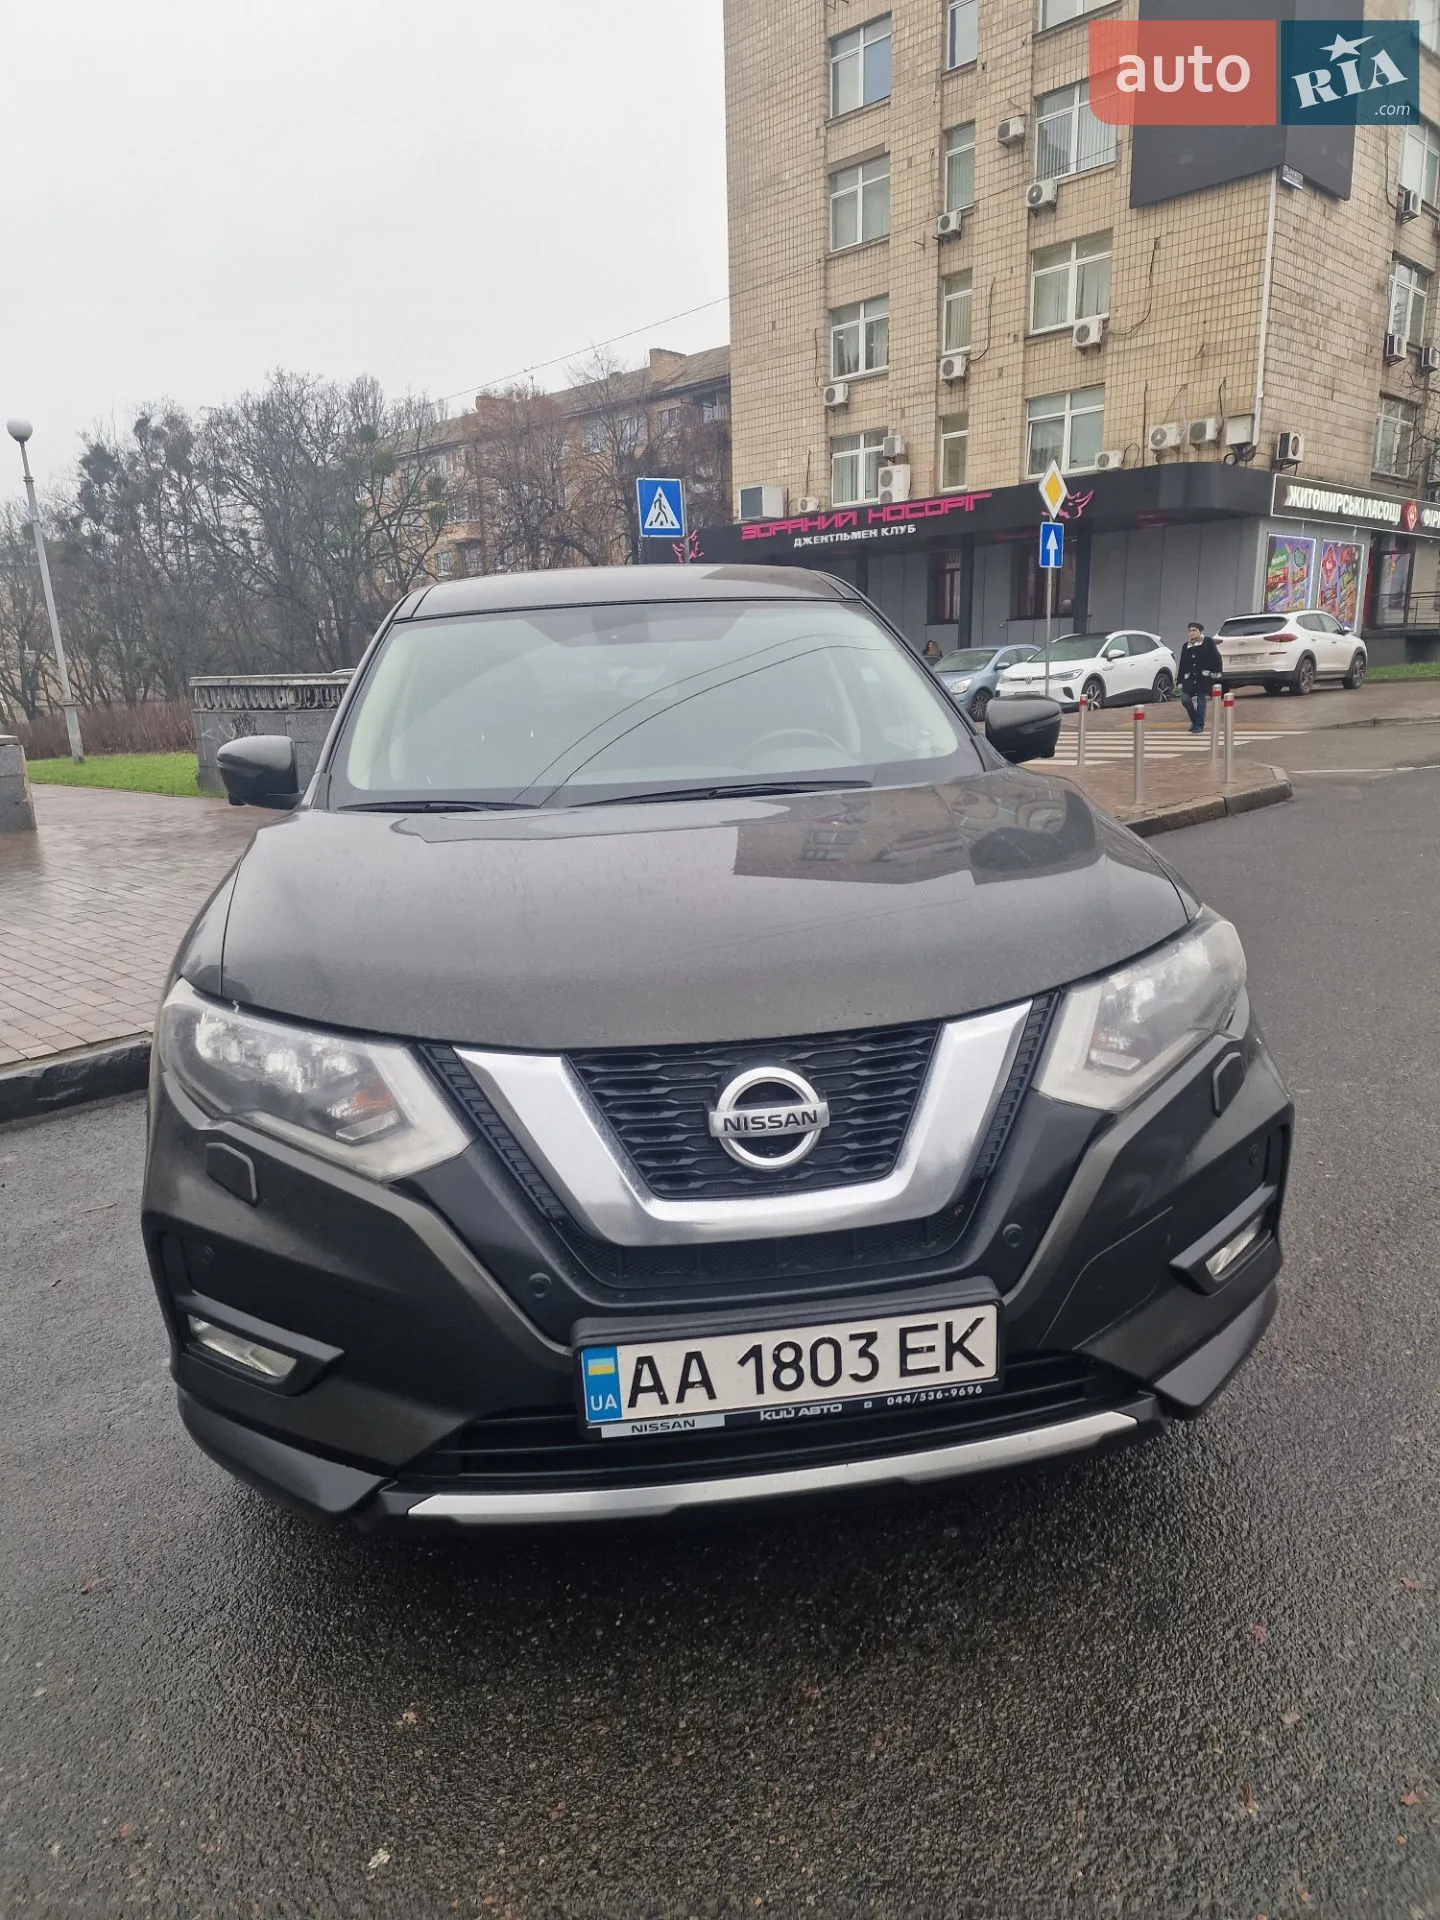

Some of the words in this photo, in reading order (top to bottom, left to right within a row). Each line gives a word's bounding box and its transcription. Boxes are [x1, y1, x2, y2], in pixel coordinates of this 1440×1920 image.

[741, 511, 857, 541] ЗОРЯНИЙ
[868, 492, 992, 524] НОСОРІГ
[1286, 485, 1364, 517] ЖИТОМИРСЬКІ
[1365, 498, 1402, 525] ЛАСОЩІ
[793, 528, 878, 548] ДЖЕНТЛЬМЕН
[881, 524, 917, 537] КЛУБ
[723, 1109, 818, 1132] NISSAN
[627, 1350, 718, 1409] AA
[736, 1330, 880, 1396] 1803
[899, 1315, 986, 1378] EK
[590, 1393, 618, 1412] UA
[886, 1385, 983, 1407] 044/536-9696
[631, 1418, 696, 1435] NISSAN
